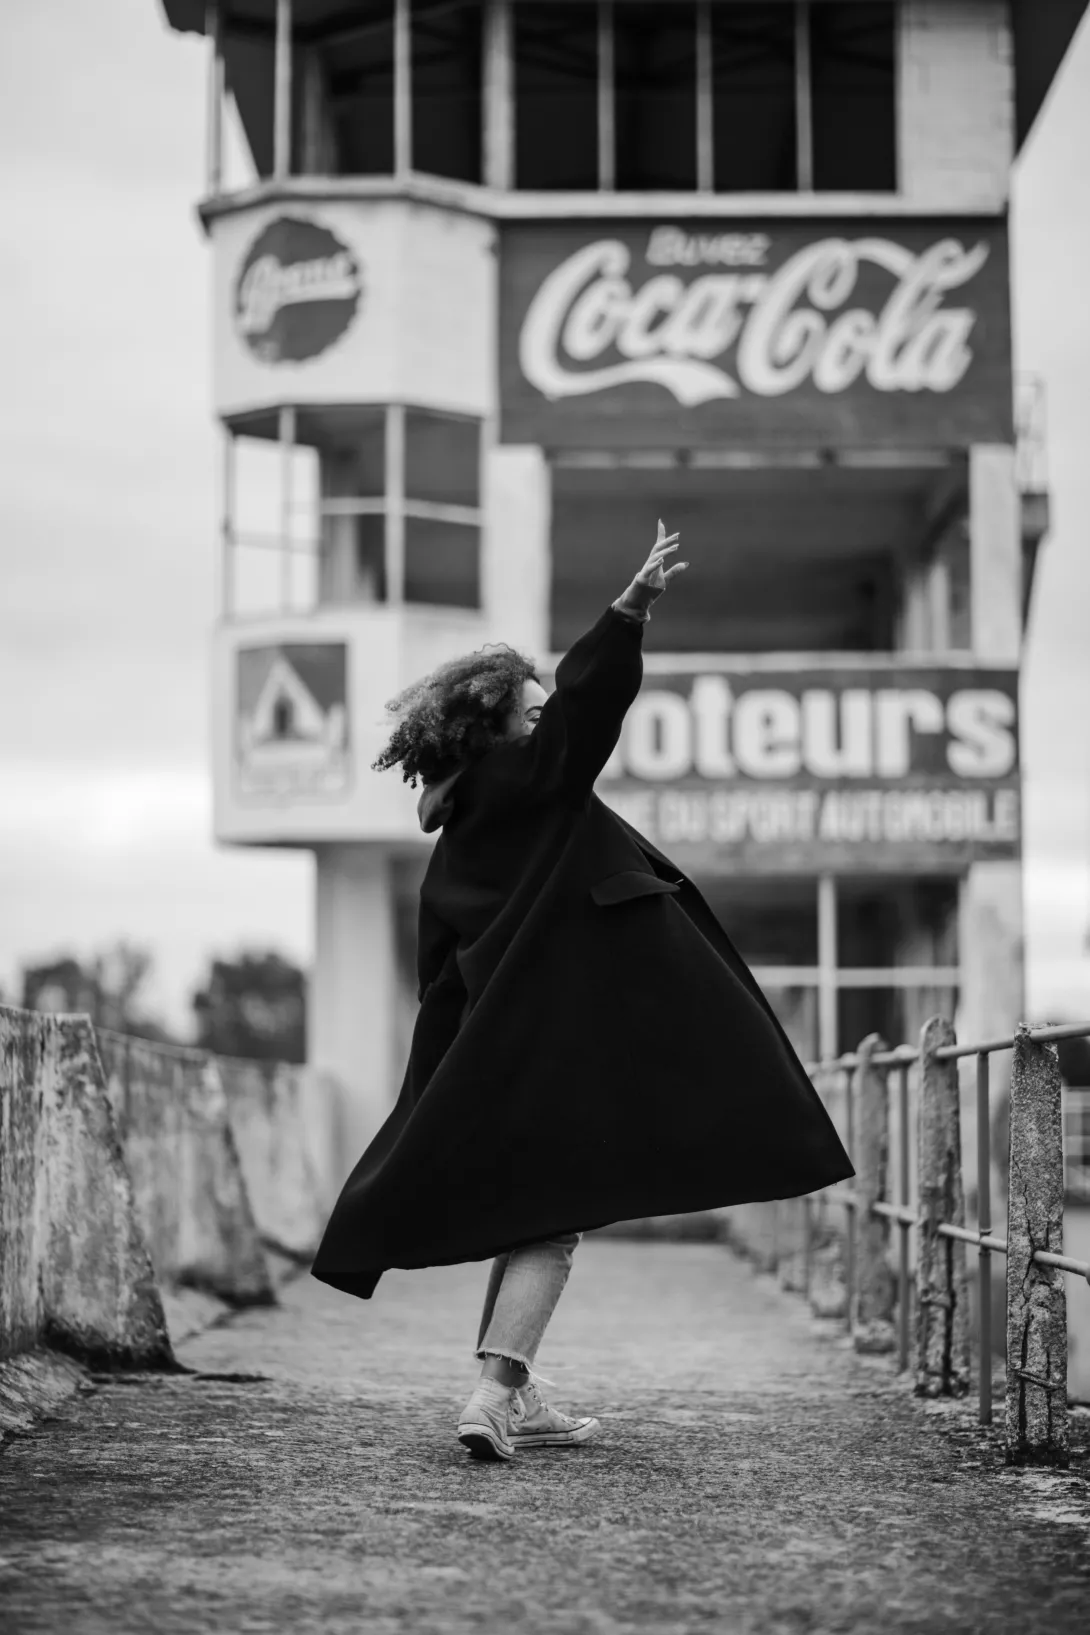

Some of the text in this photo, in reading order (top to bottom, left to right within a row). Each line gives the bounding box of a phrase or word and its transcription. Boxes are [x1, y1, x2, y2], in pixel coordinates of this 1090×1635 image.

[519, 238, 990, 406] Coca-Cola
[602, 674, 1016, 780] oteurs
[708, 789, 817, 842] SPORT
[818, 789, 1018, 842] AUTOMOBILE
